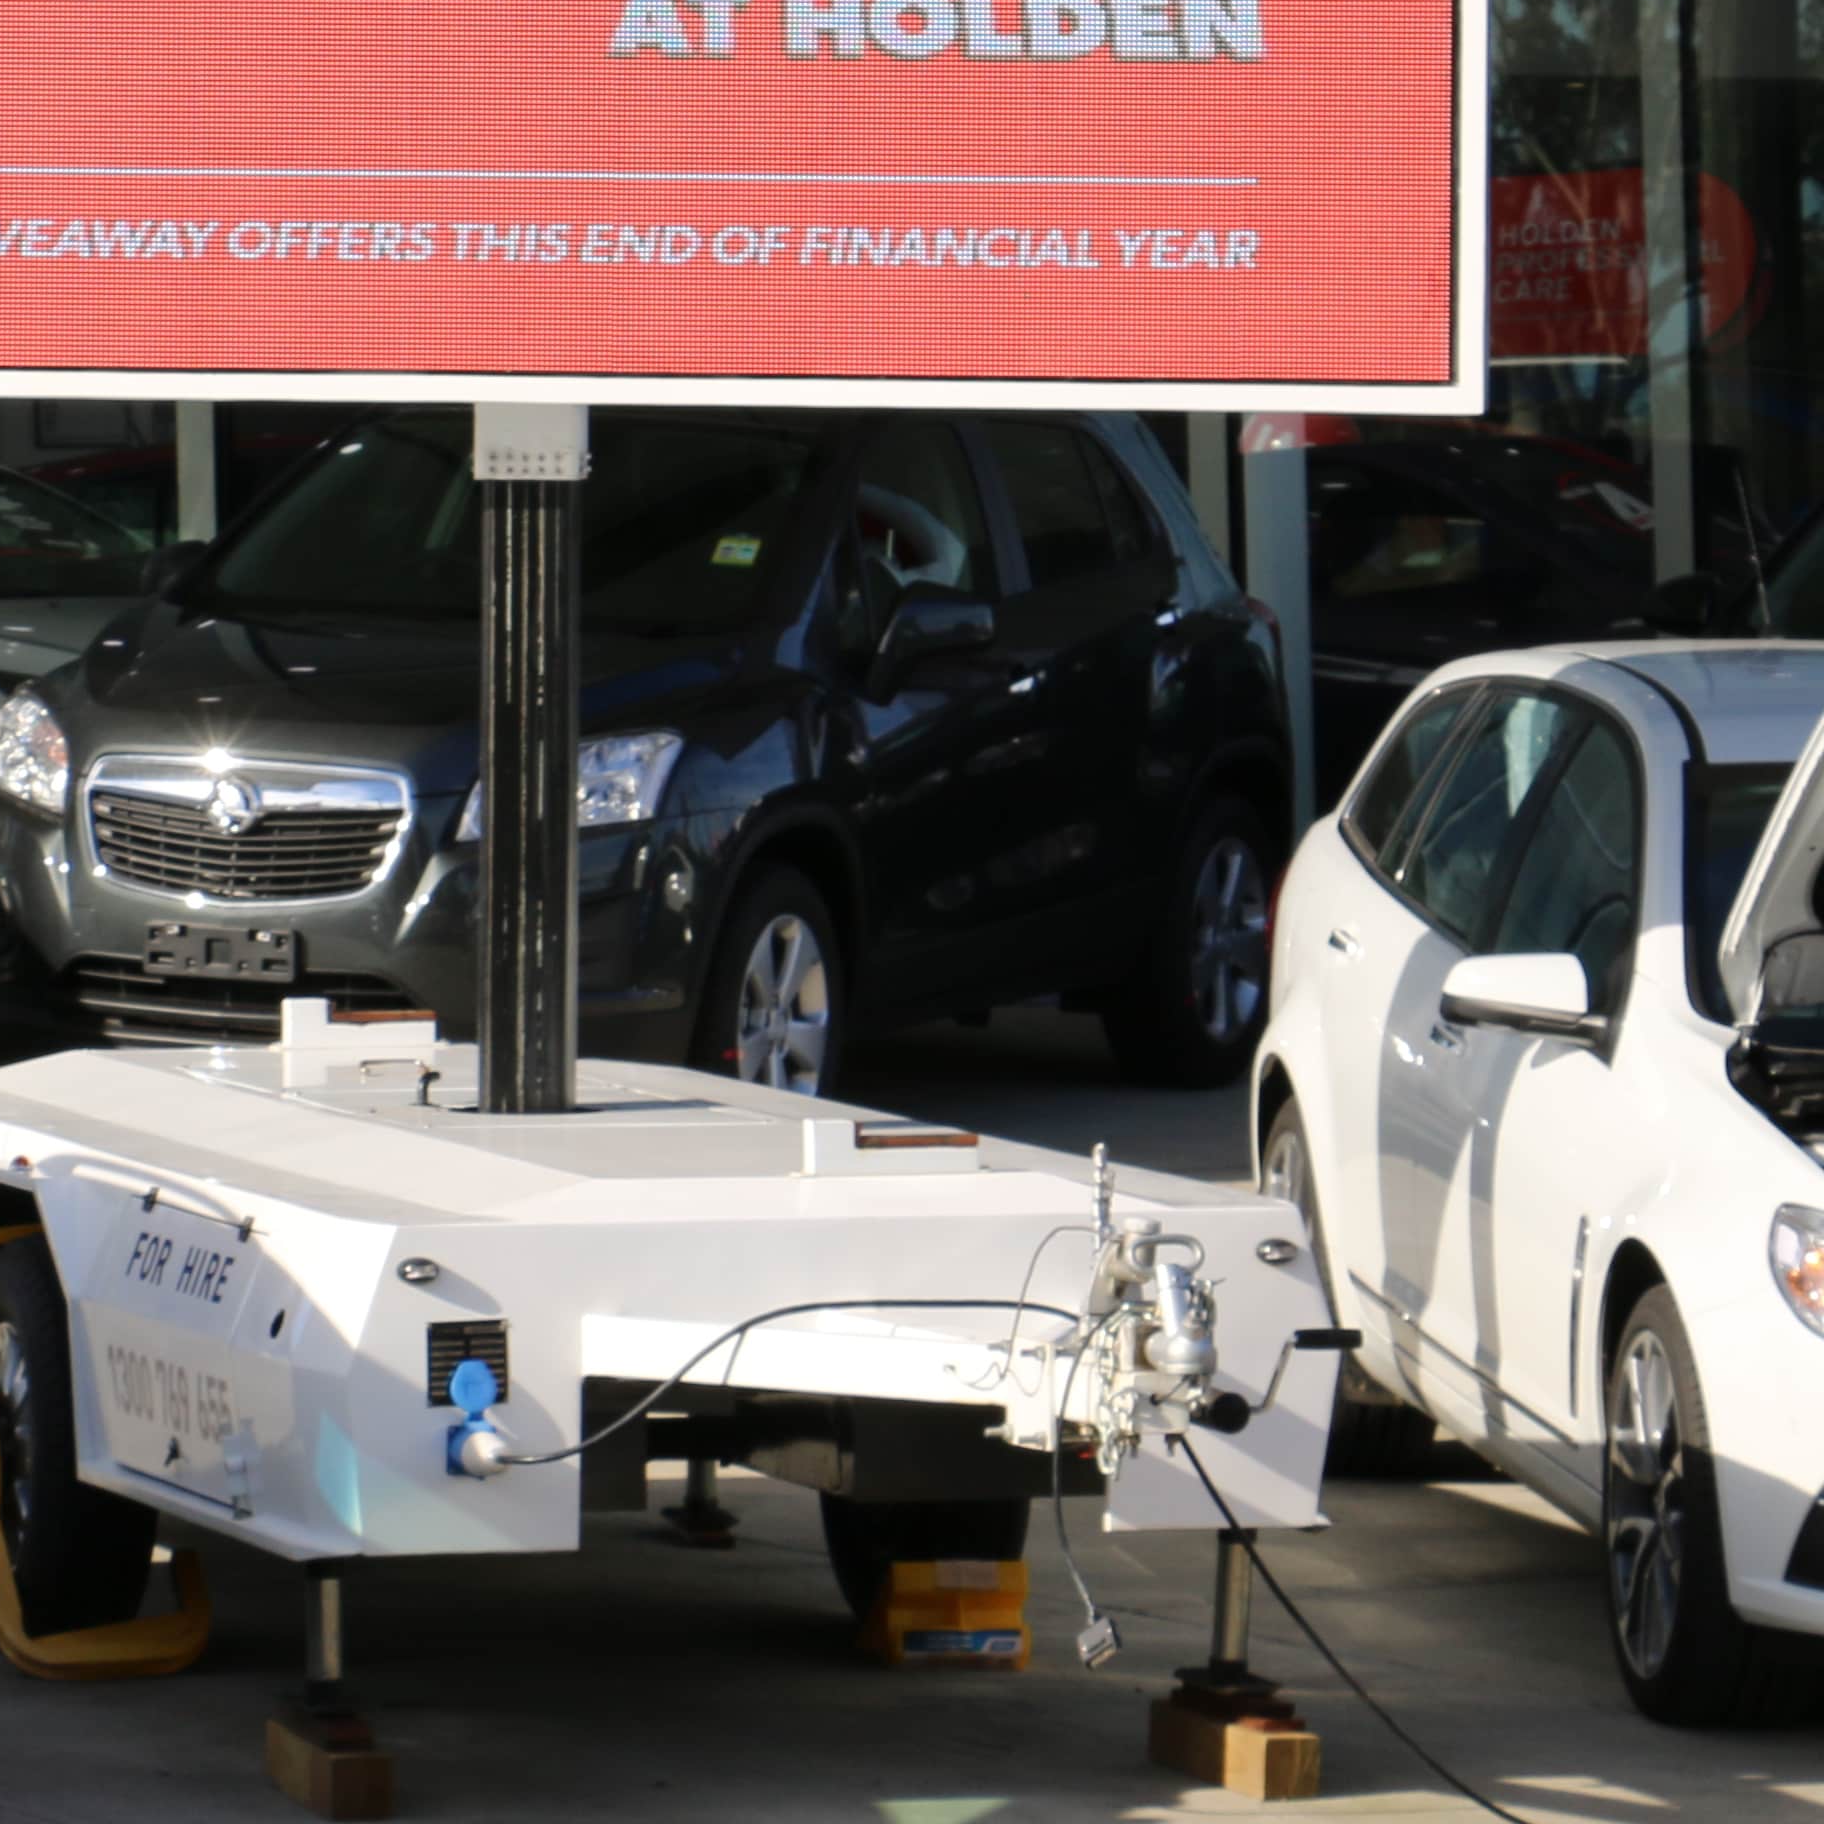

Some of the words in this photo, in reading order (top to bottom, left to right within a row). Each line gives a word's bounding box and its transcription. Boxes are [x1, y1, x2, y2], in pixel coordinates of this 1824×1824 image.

[227, 220, 437, 262] OFFERS
[452, 223, 572, 262] THIS
[578, 223, 704, 264] END
[712, 225, 792, 265] OF
[798, 226, 1101, 268] FINANCIAL
[1115, 229, 1262, 270] YEAR
[1497, 216, 1622, 248] HOLDEN
[1494, 276, 1575, 305] CARE
[124, 1231, 173, 1286] FOR
[175, 1244, 236, 1304] HIRE
[107, 1343, 156, 1422] 1300
